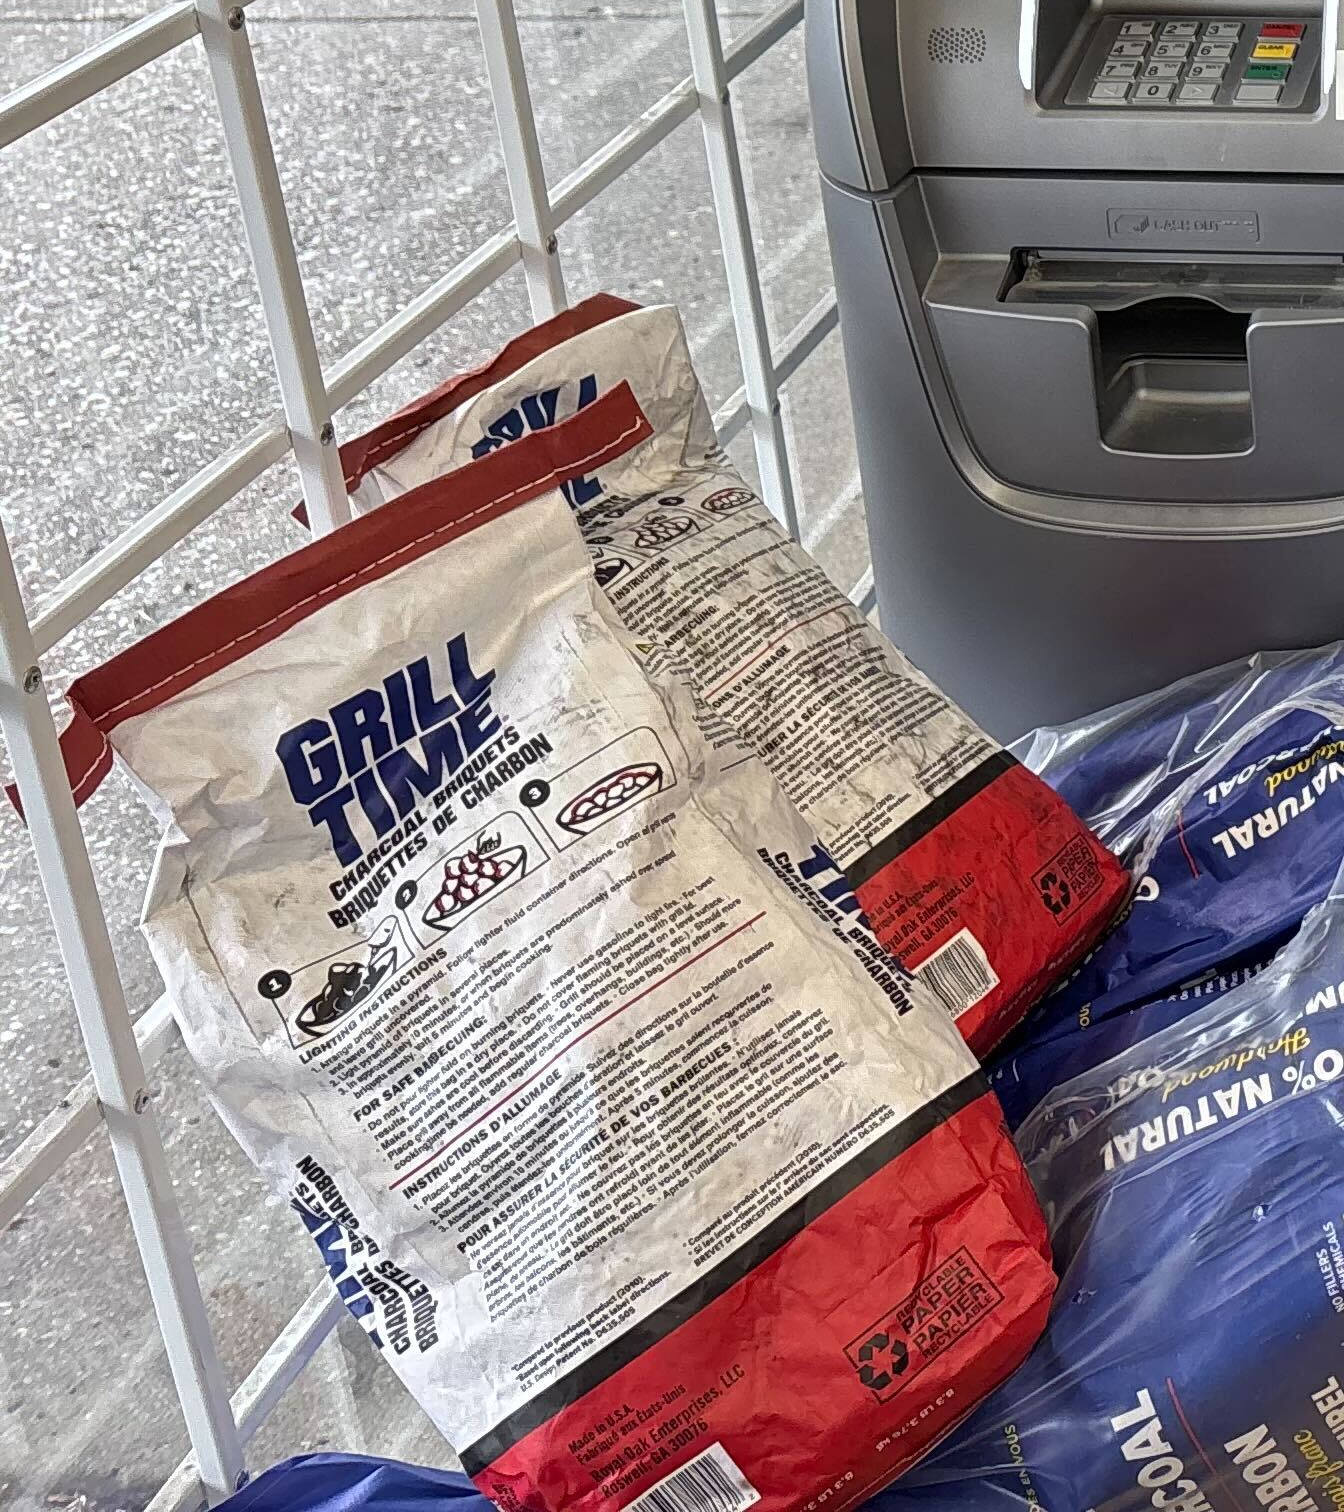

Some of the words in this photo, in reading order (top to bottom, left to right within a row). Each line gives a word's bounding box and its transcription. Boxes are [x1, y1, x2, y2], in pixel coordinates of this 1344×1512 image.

[275, 632, 496, 805] GRILL
[308, 687, 501, 868] TIME
[327, 837, 428, 930] BRIQUETTES
[434, 811, 458, 838] DE
[459, 733, 553, 810] CHARBON
[329, 813, 428, 902] CHARCOAL
[432, 725, 520, 809] BRIQUETS
[299, 1023, 358, 1064] LIGHTING
[358, 948, 448, 1023] INSTRUCTIONS
[854, 949, 914, 1017] CHARBON
[353, 1098, 380, 1122] FOR
[382, 1072, 415, 1101] SAFE
[415, 1016, 488, 1077] BARBECUING:
[402, 1130, 489, 1199] INSTRUCTIONS
[490, 1068, 562, 1133] D'ALLUMAGE
[902, 1266, 975, 1334] PAPER
[913, 1282, 987, 1351] PAPIER
[922, 1293, 994, 1359] RECYCLABLE
[1316, 1248, 1340, 1296] FILLERS
[590, 1455, 625, 1482] Royal
[624, 1438, 650, 1460] Oak
[650, 1387, 723, 1443] Enterprises,
[720, 1364, 745, 1388] LLC
[601, 1461, 652, 1498] Roswell,
[651, 1445, 670, 1465] GA
[669, 1421, 708, 1450] 30076
